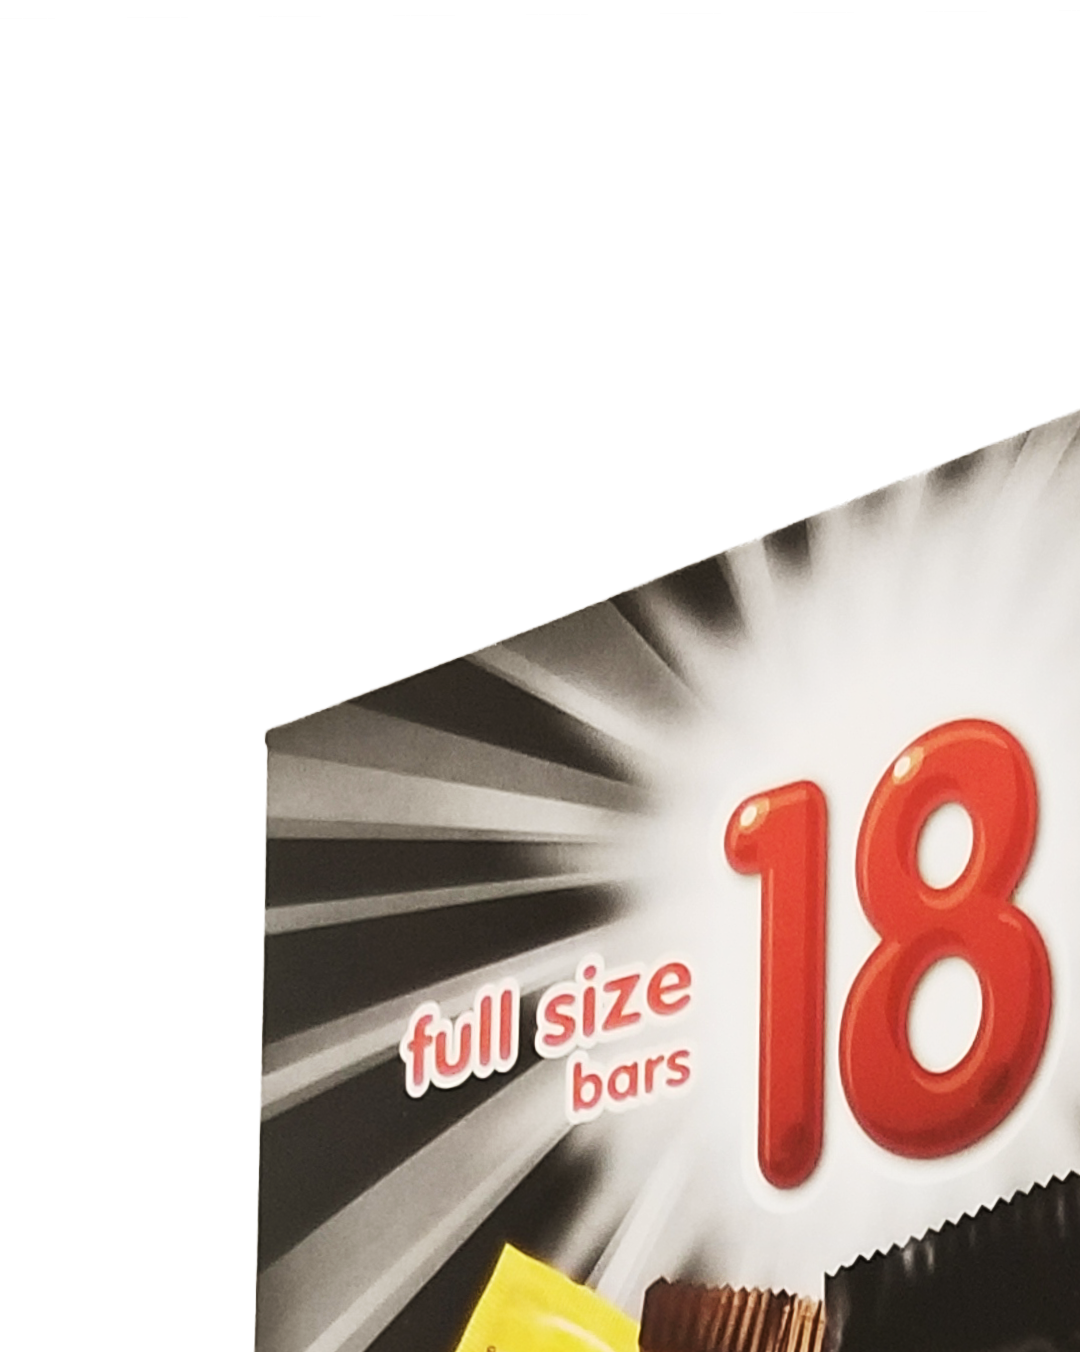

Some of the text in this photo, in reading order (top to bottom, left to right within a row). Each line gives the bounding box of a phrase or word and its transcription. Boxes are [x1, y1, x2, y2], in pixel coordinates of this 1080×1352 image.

[724, 718, 1052, 1190] 18
[405, 960, 692, 1089] full size
[571, 1050, 692, 1112] bars
